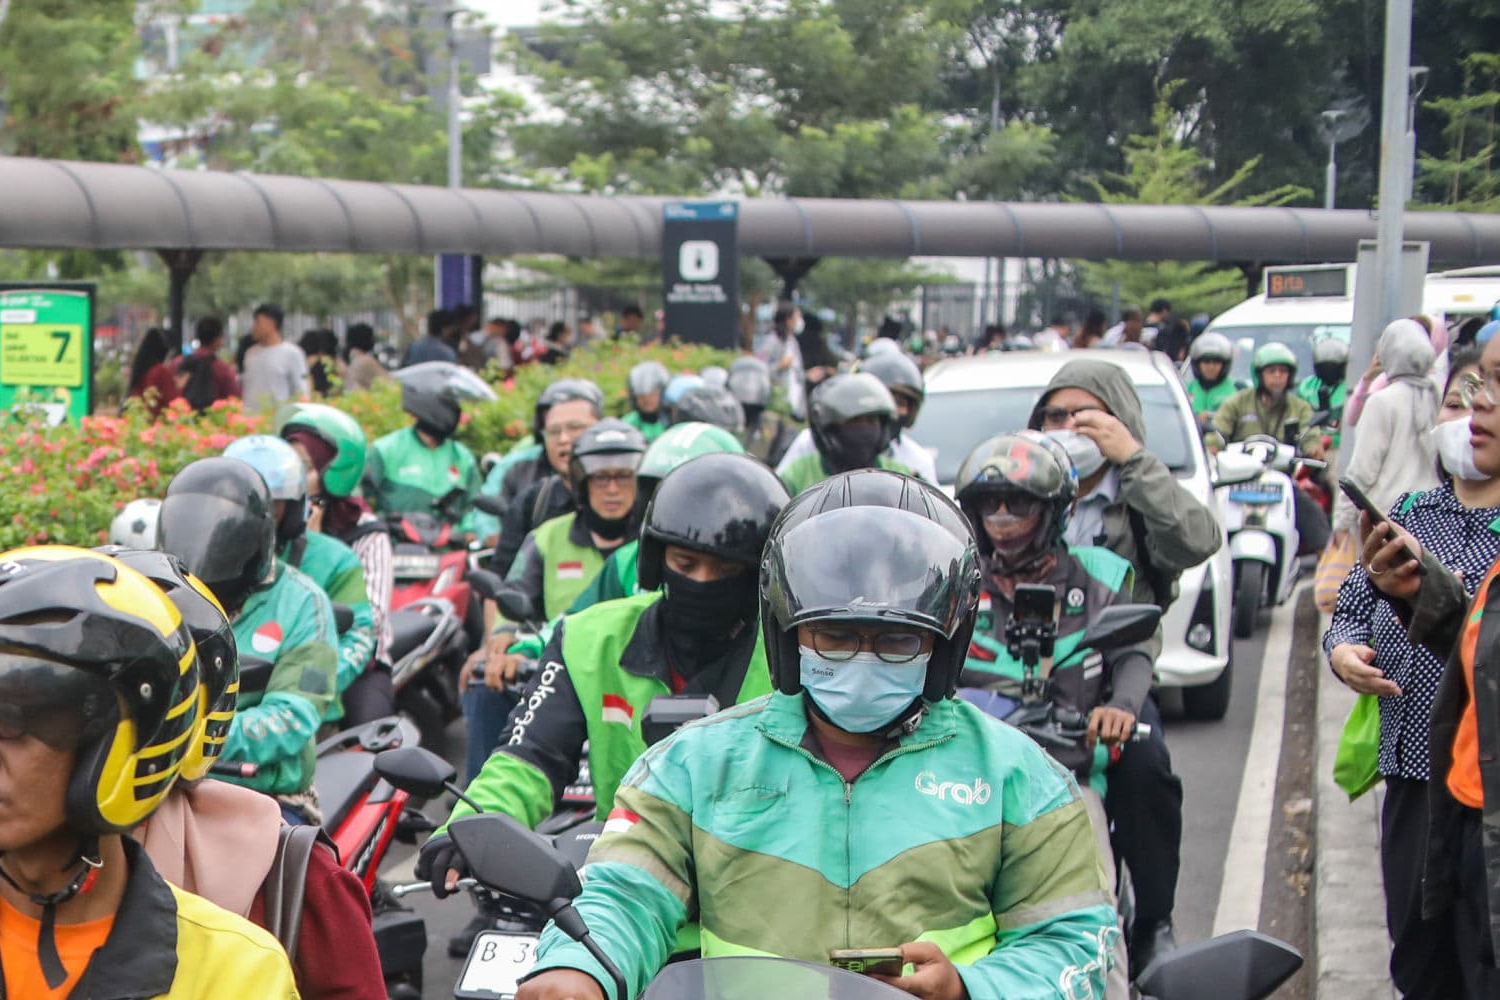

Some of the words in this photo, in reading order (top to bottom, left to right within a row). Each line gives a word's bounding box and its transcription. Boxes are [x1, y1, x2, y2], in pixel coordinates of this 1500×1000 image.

[50, 331, 71, 363] 7
[915, 769, 991, 806] Grab
[481, 941, 498, 963] B
